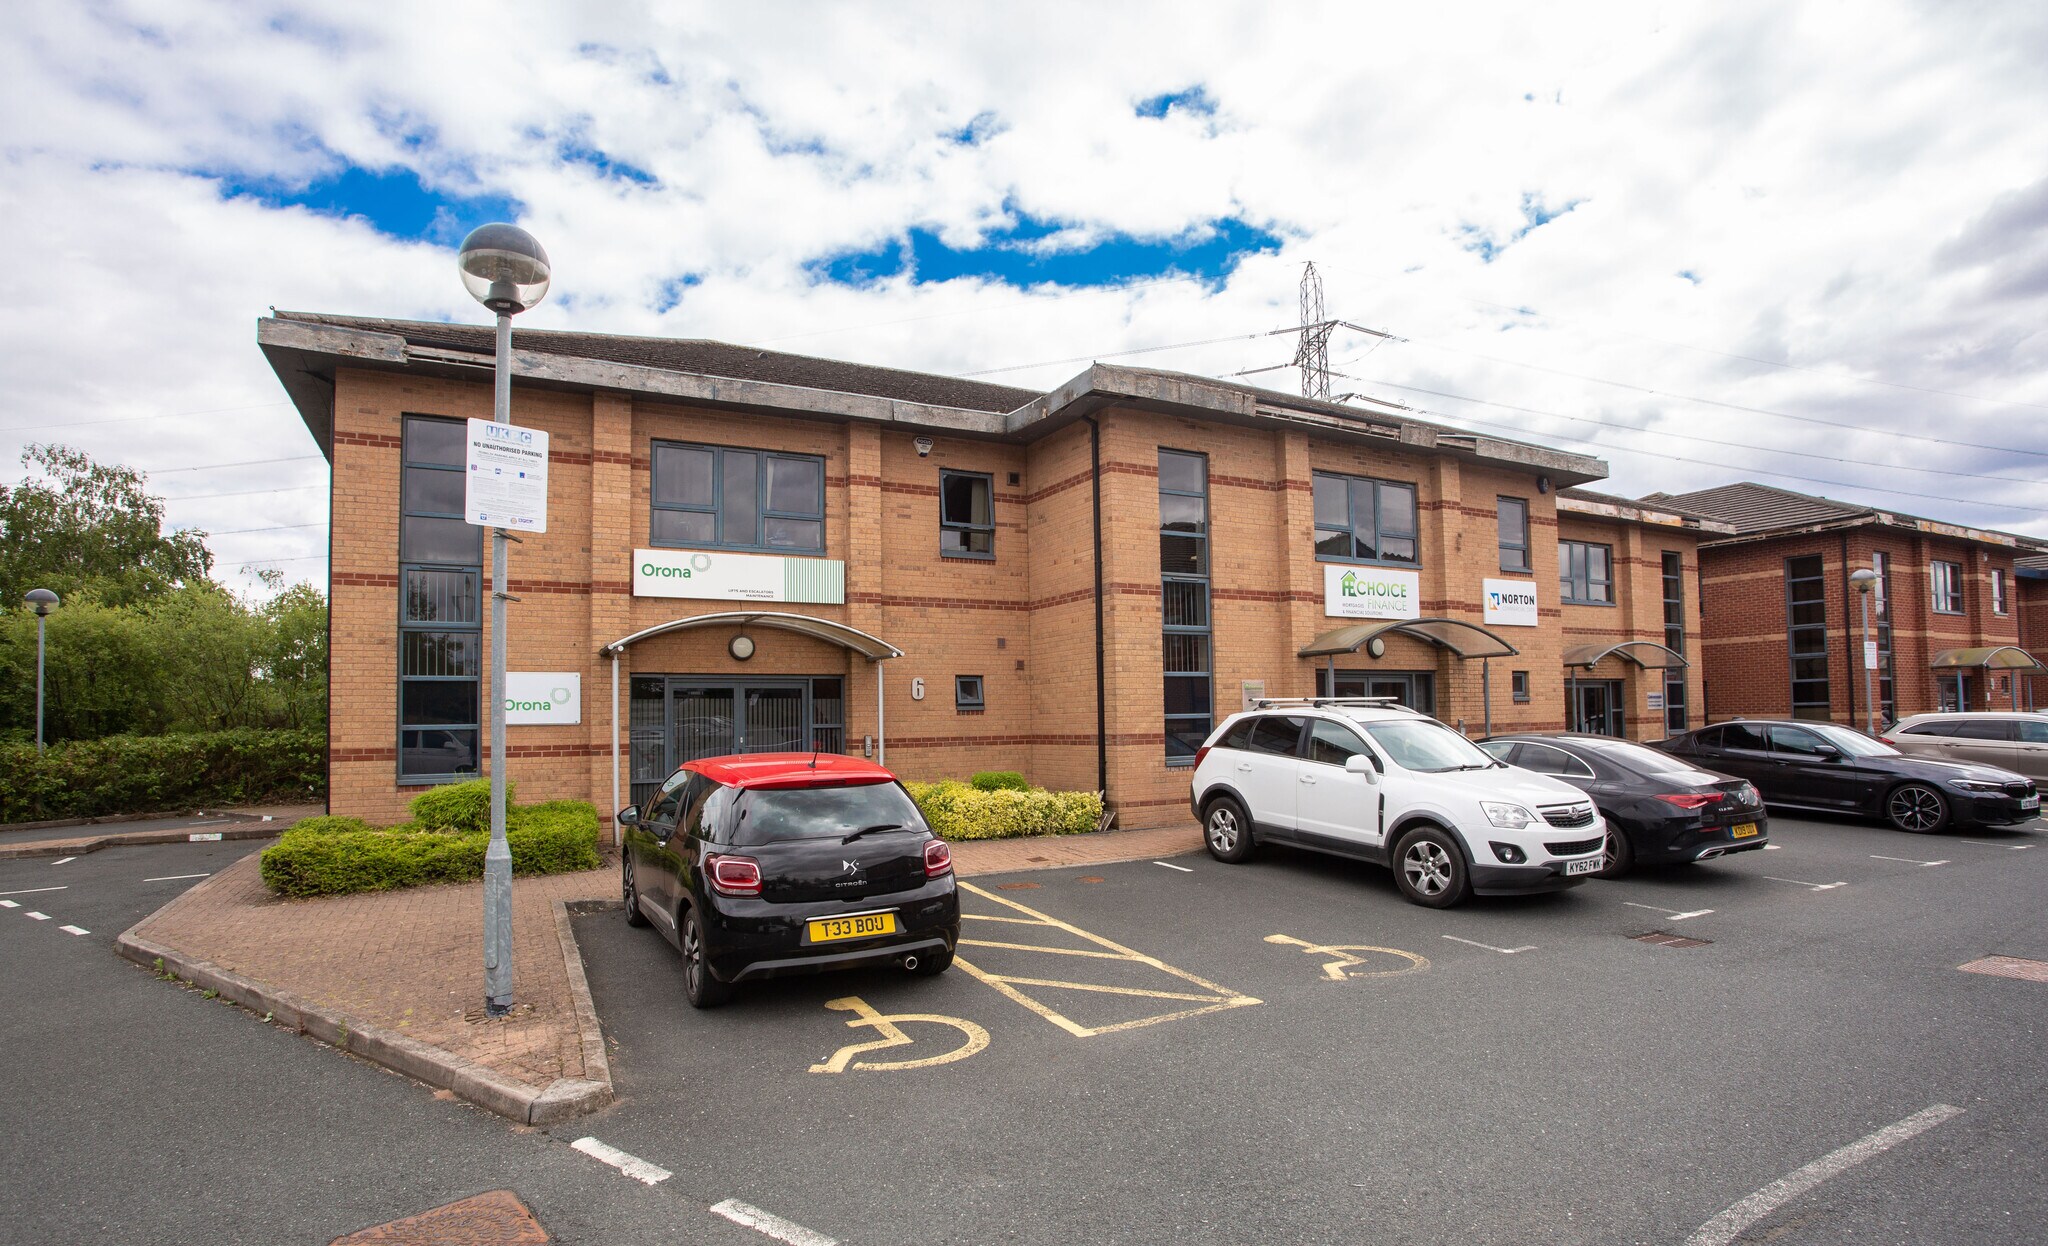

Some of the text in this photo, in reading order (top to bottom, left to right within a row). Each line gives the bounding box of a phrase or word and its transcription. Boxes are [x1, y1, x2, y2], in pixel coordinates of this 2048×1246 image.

[482, 442, 521, 455] UNAUTHORISED
[521, 450, 543, 459] PARKING
[641, 563, 691, 578] Orona
[1356, 580, 1407, 598] CHOICE
[1367, 599, 1407, 612] FINANCE
[1501, 593, 1535, 605] NORTON
[911, 677, 925, 700] 6
[504, 699, 551, 711] Orona
[1569, 860, 1601, 873] KY62 FWK
[821, 920, 852, 937] T33
